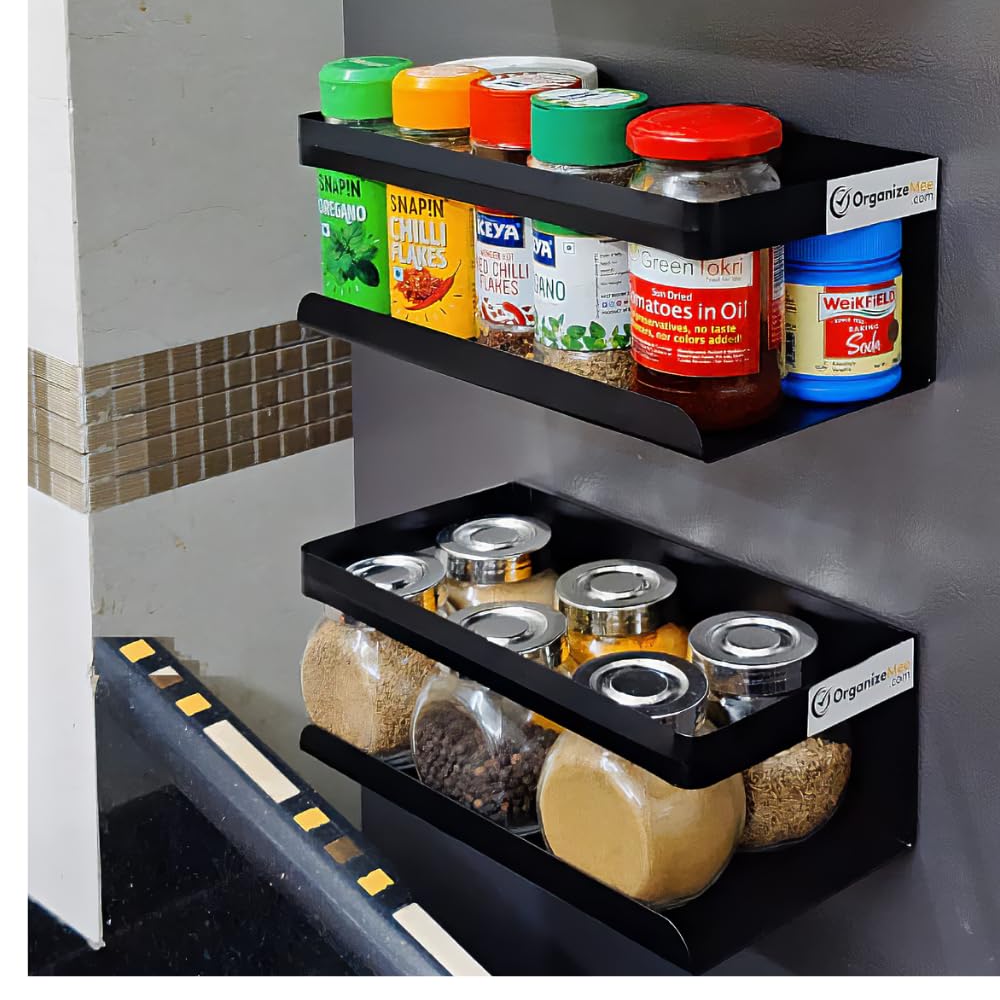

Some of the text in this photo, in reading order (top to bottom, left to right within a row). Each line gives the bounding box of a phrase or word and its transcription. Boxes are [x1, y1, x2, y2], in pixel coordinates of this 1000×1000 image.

[317, 198, 367, 224] OREGANO
[390, 194, 444, 218] SNAP!N
[390, 216, 447, 248] CHILLI
[477, 219, 520, 241] KEYA
[390, 242, 448, 270] FLAKES
[533, 237, 553, 259] YA
[479, 258, 529, 279] ED CHILLI
[640, 250, 694, 276] Green
[630, 291, 748, 320] omatoes in Oil
[651, 287, 693, 302] Sun Dried
[673, 333, 706, 345] colors
[694, 325, 708, 334] no
[711, 325, 737, 334] taste
[846, 329, 881, 355] Soda
